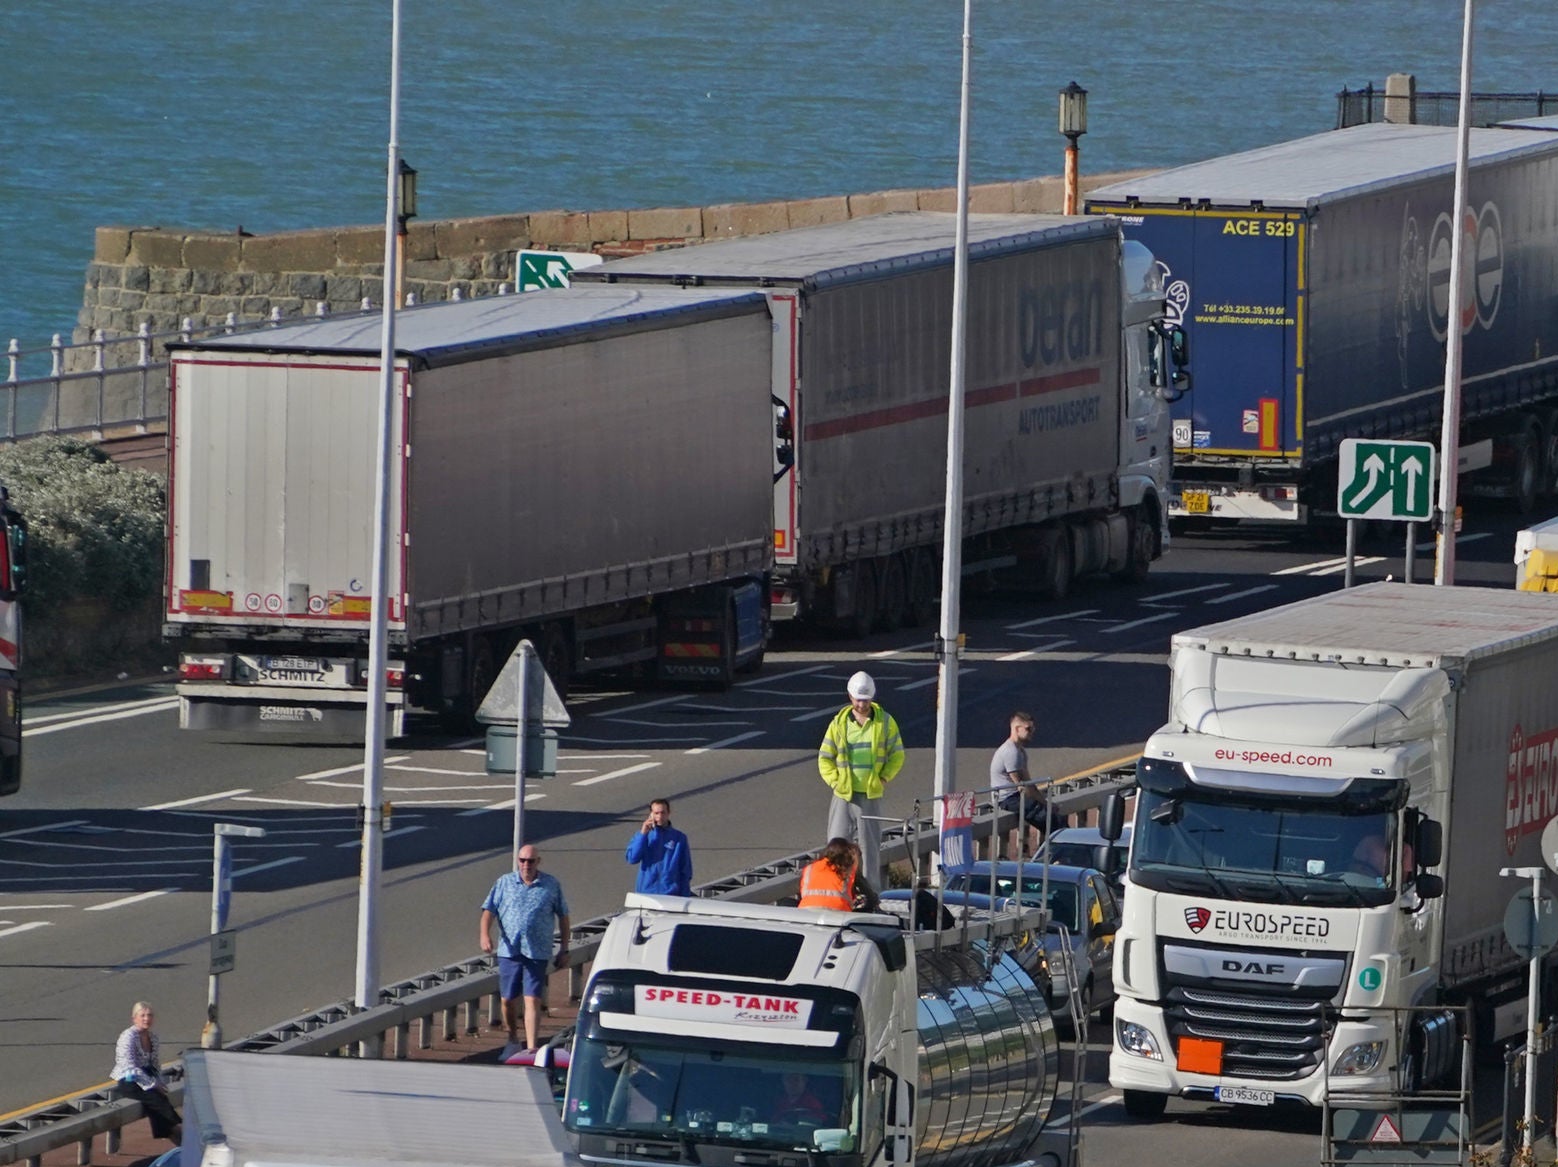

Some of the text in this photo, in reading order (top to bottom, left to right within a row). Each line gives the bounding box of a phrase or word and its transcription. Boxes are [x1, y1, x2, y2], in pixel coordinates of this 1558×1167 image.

[1222, 220, 1295, 237] ACE 529
[1019, 396, 1100, 436] AUTOTRANSPORT
[1175, 427, 1189, 441] 90
[260, 670, 325, 683] SCHMITZ
[665, 665, 720, 675] VOLVO
[259, 705, 305, 715] SCHMITZ
[1215, 748, 1332, 767] eu-speed.com
[1215, 909, 1330, 937] EUROSPEED
[1240, 933, 1284, 942] TRANSPORT
[1285, 935, 1308, 943] SINCE
[1222, 960, 1285, 975] DAF
[1364, 971, 1376, 988] L
[645, 988, 798, 1014] SPEED-TANK
[1221, 1088, 1234, 1098] CB
[1235, 1090, 1259, 1101] 9536
